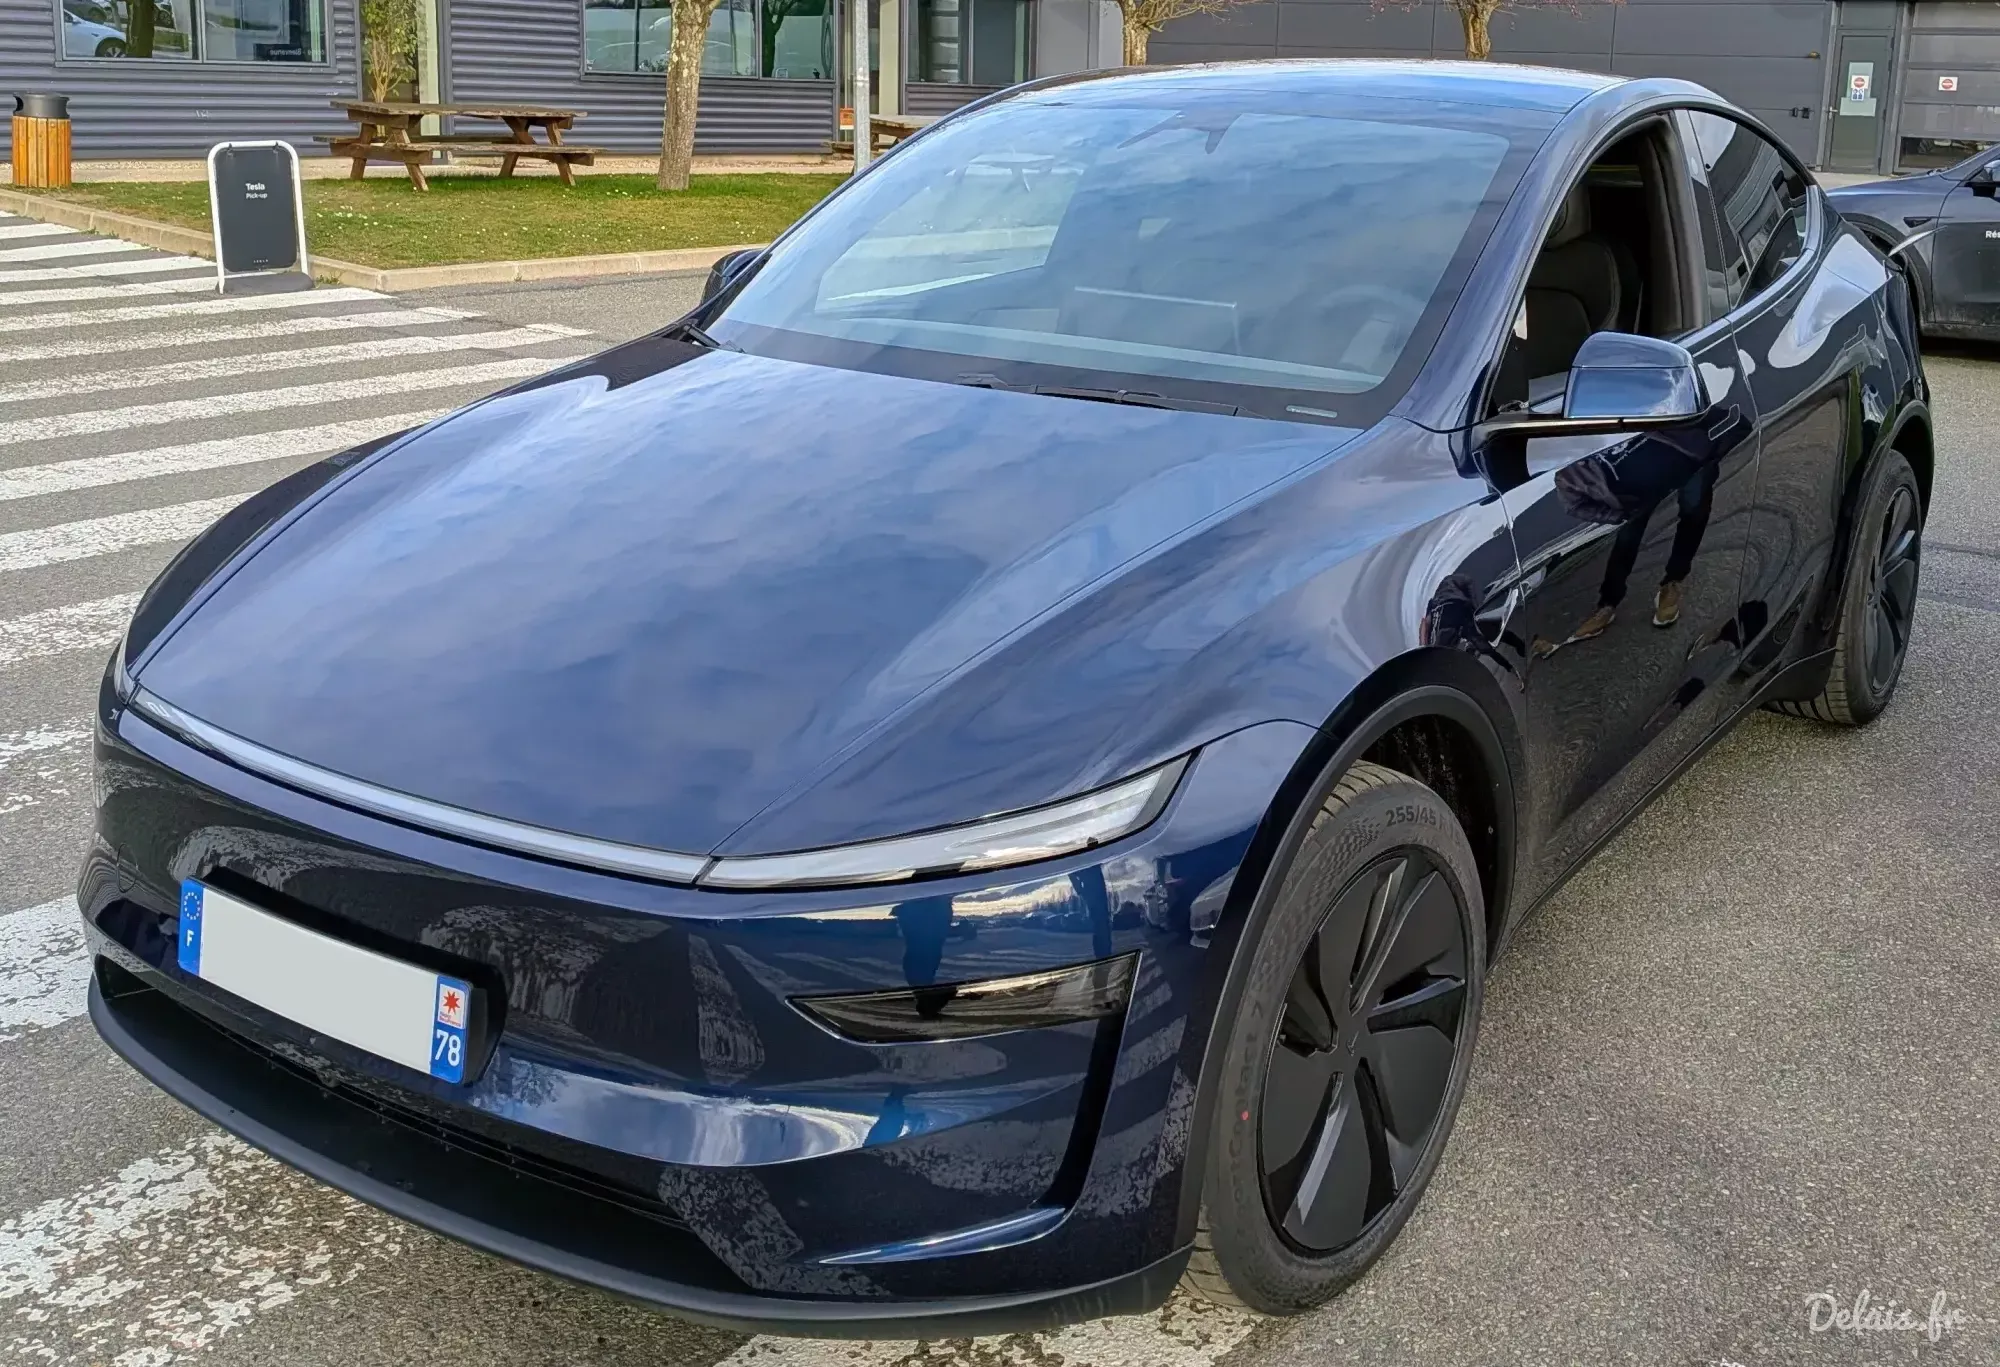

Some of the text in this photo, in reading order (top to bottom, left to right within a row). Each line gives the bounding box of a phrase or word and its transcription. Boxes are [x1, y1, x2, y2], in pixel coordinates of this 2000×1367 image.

[245, 182, 266, 190] Tesla
[1386, 804, 1437, 828] 255/45
[186, 929, 195, 947] F
[434, 1028, 461, 1067] 78
